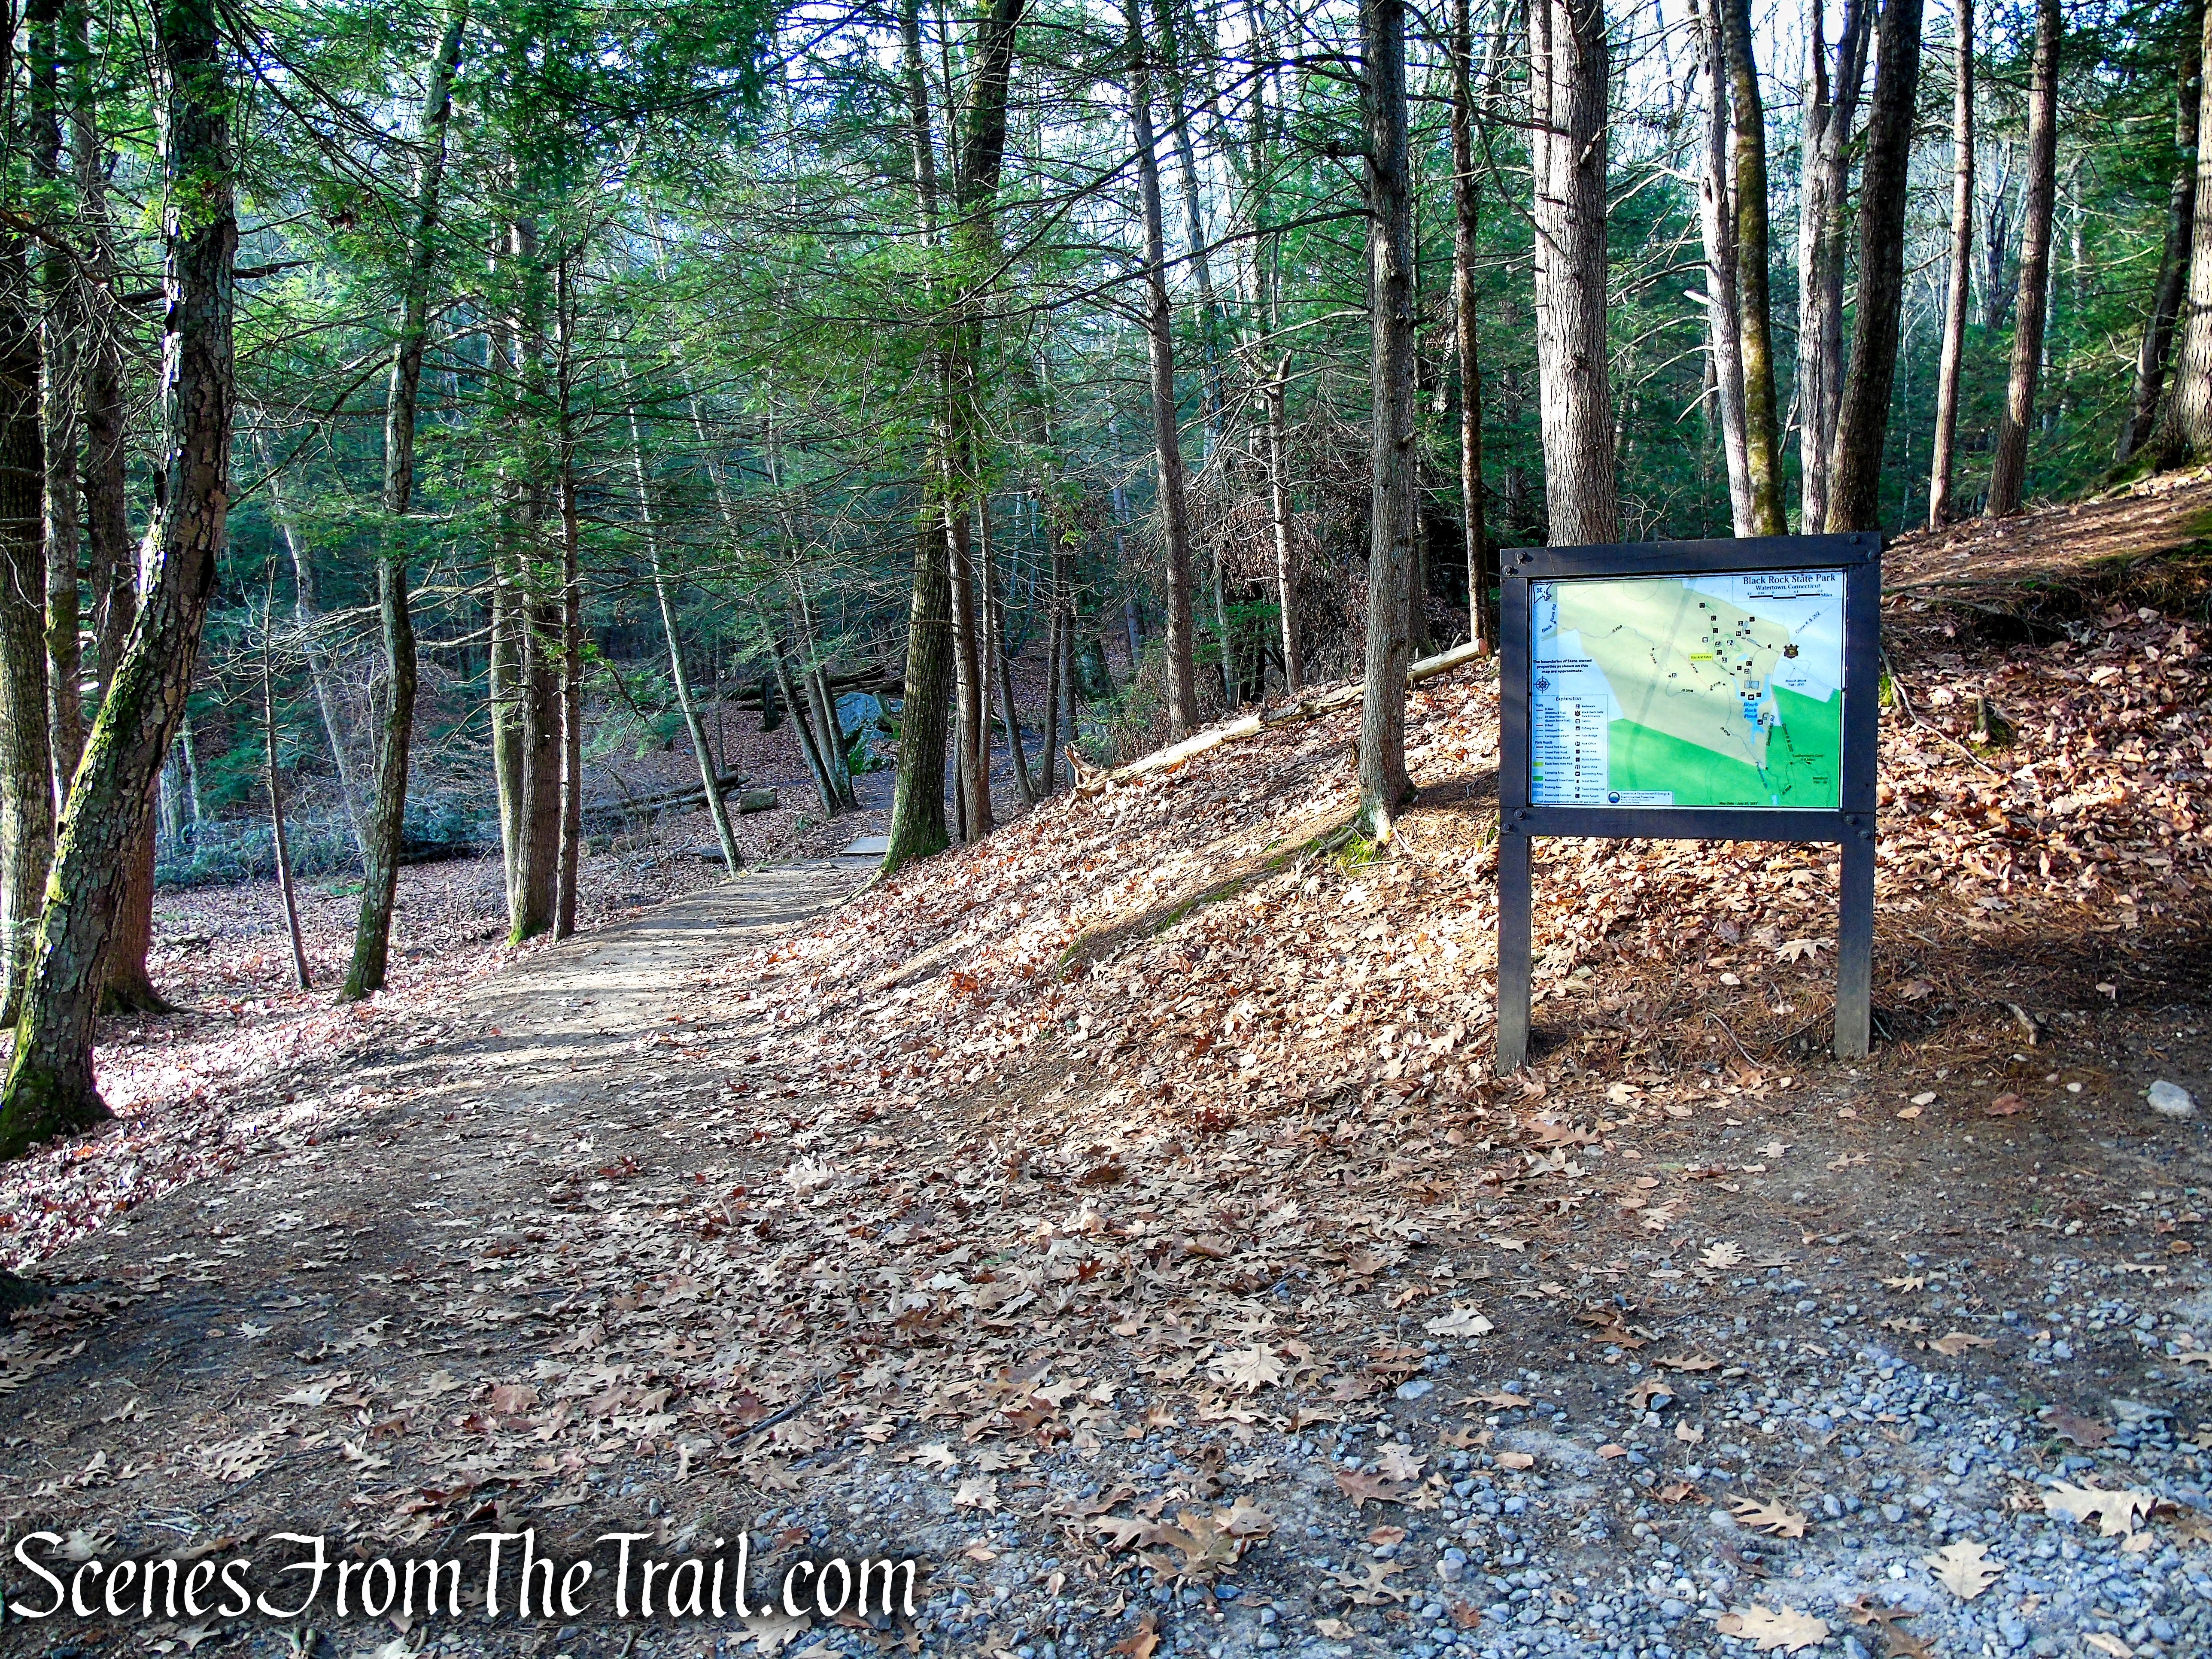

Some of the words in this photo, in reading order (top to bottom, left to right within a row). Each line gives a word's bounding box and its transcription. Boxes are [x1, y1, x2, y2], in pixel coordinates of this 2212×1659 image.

[1743, 576, 1766, 584] Black
[1769, 575, 1789, 583] Rock
[1792, 574, 1813, 583] State
[1816, 574, 1835, 582] Park
